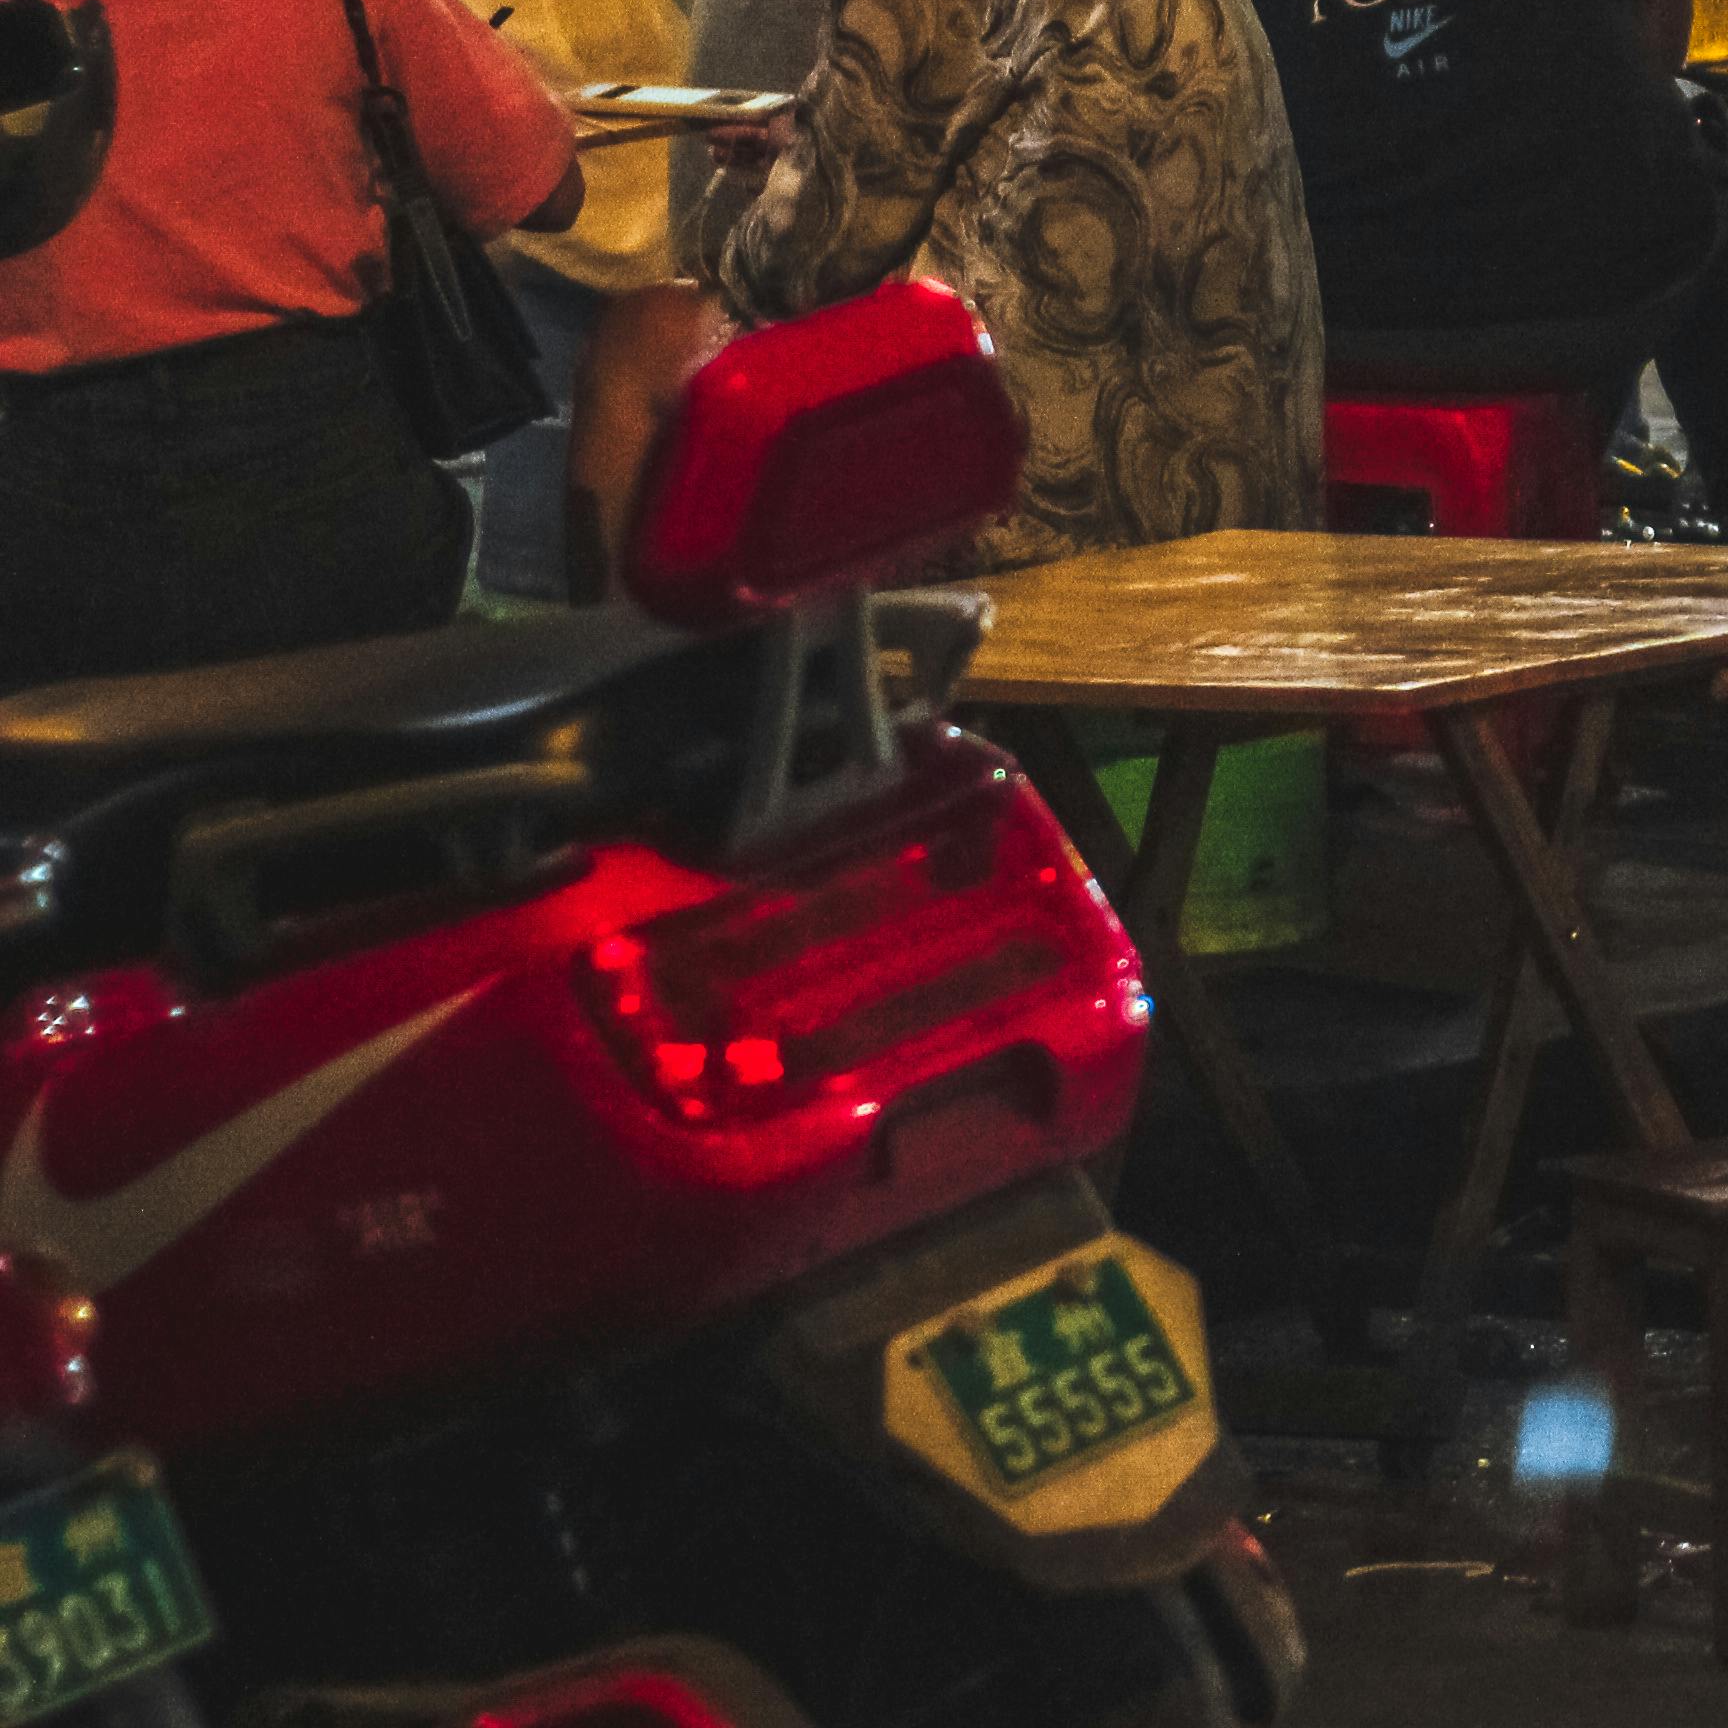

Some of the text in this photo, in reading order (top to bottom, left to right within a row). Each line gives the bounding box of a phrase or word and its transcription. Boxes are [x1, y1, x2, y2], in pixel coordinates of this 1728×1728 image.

[1390, 5, 1440, 32] NIKE
[1397, 56, 1450, 79] AIR
[978, 1333, 1181, 1473] 55555
